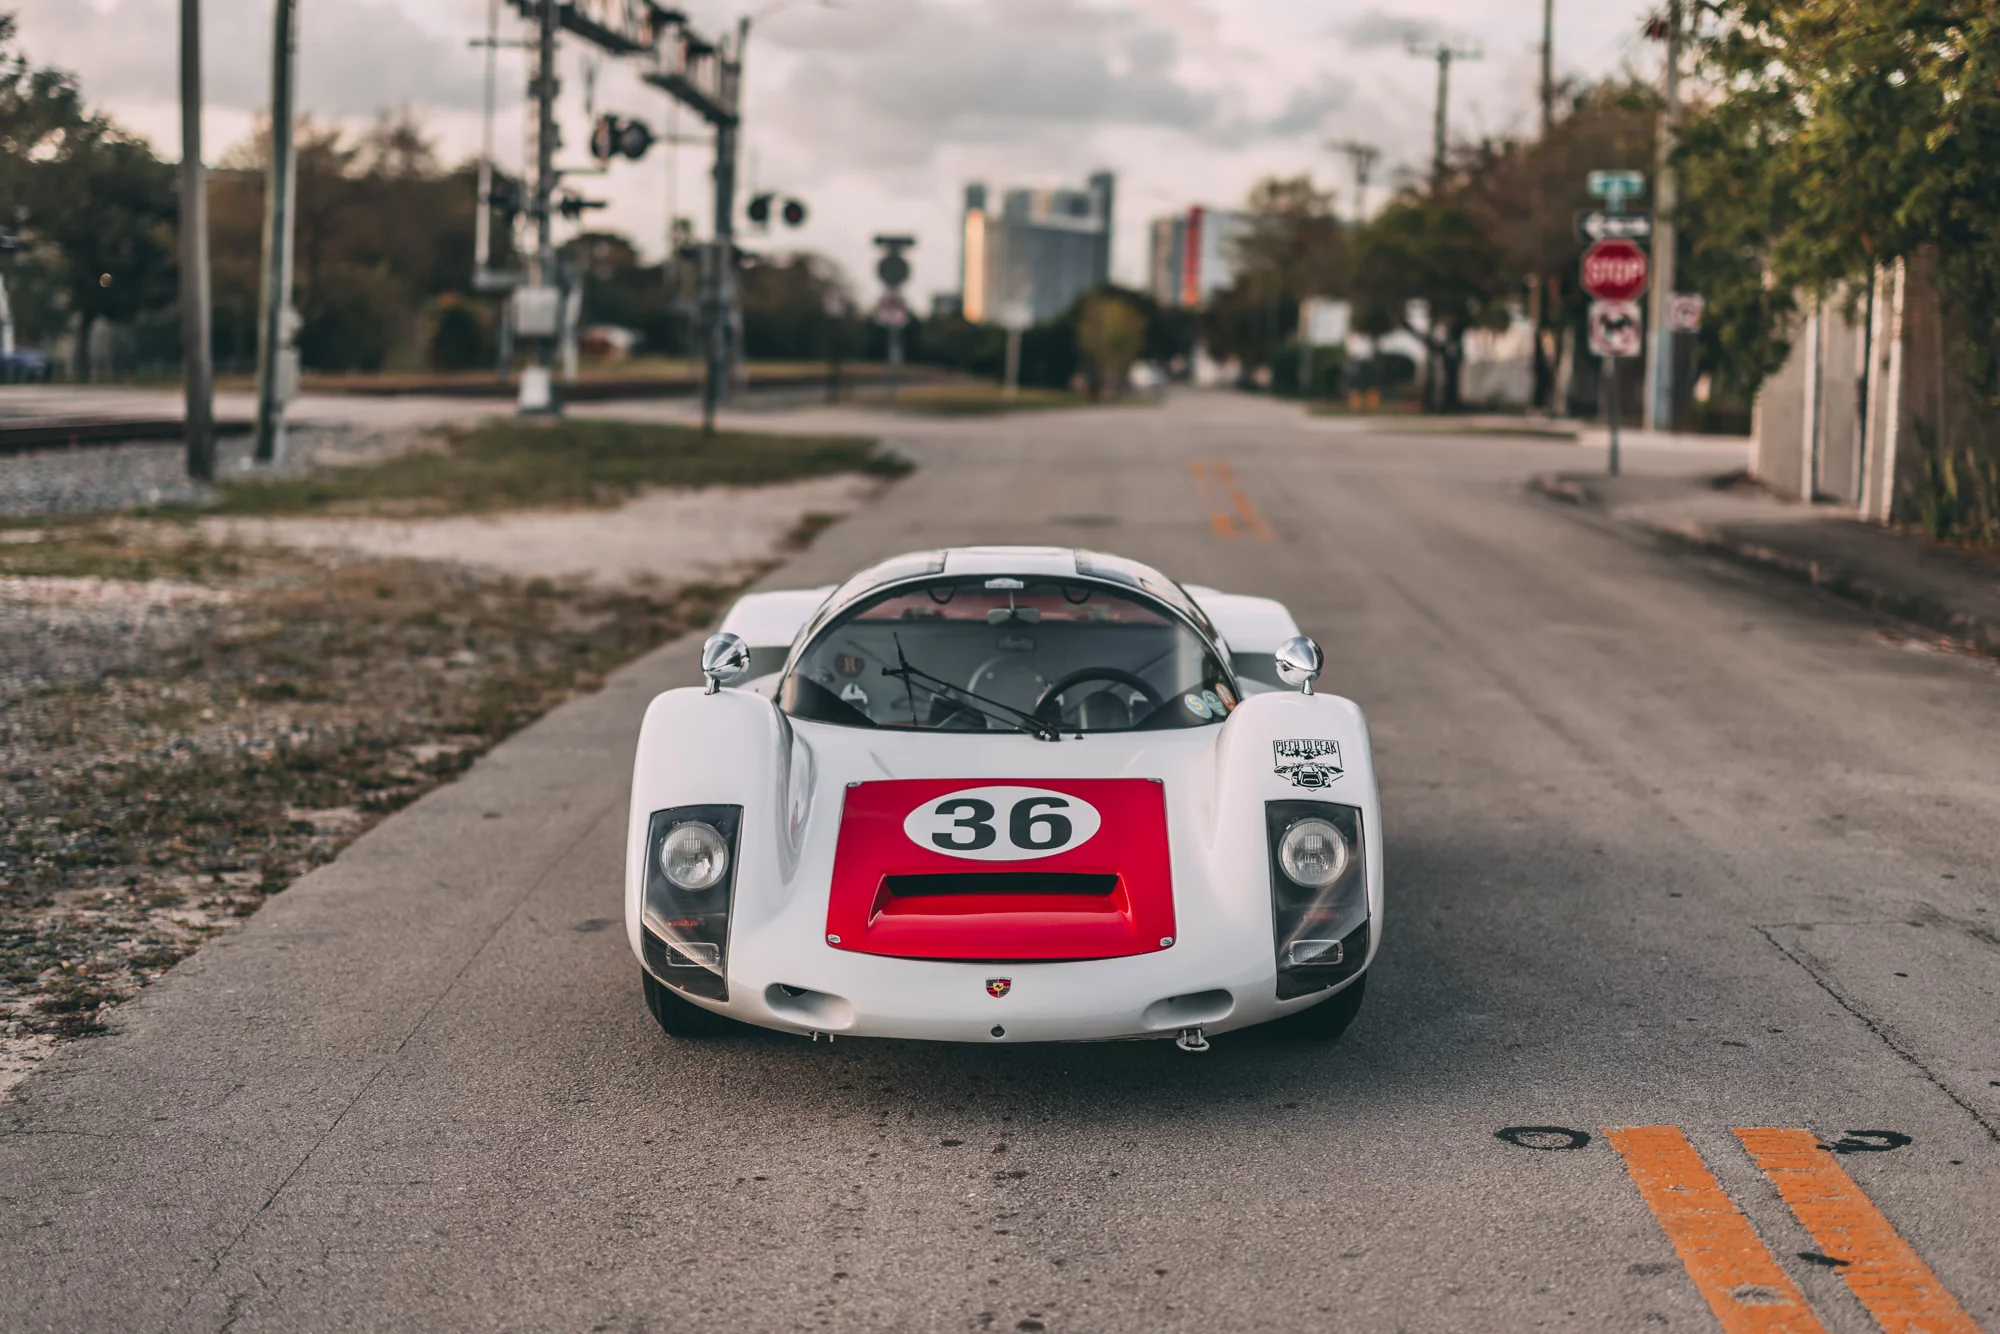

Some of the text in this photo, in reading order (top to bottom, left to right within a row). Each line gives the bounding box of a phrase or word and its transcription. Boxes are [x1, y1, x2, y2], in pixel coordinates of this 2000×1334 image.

[1584, 257, 1645, 286] STOP
[1314, 740, 1337, 753] PEAK
[931, 796, 1073, 851] 36
